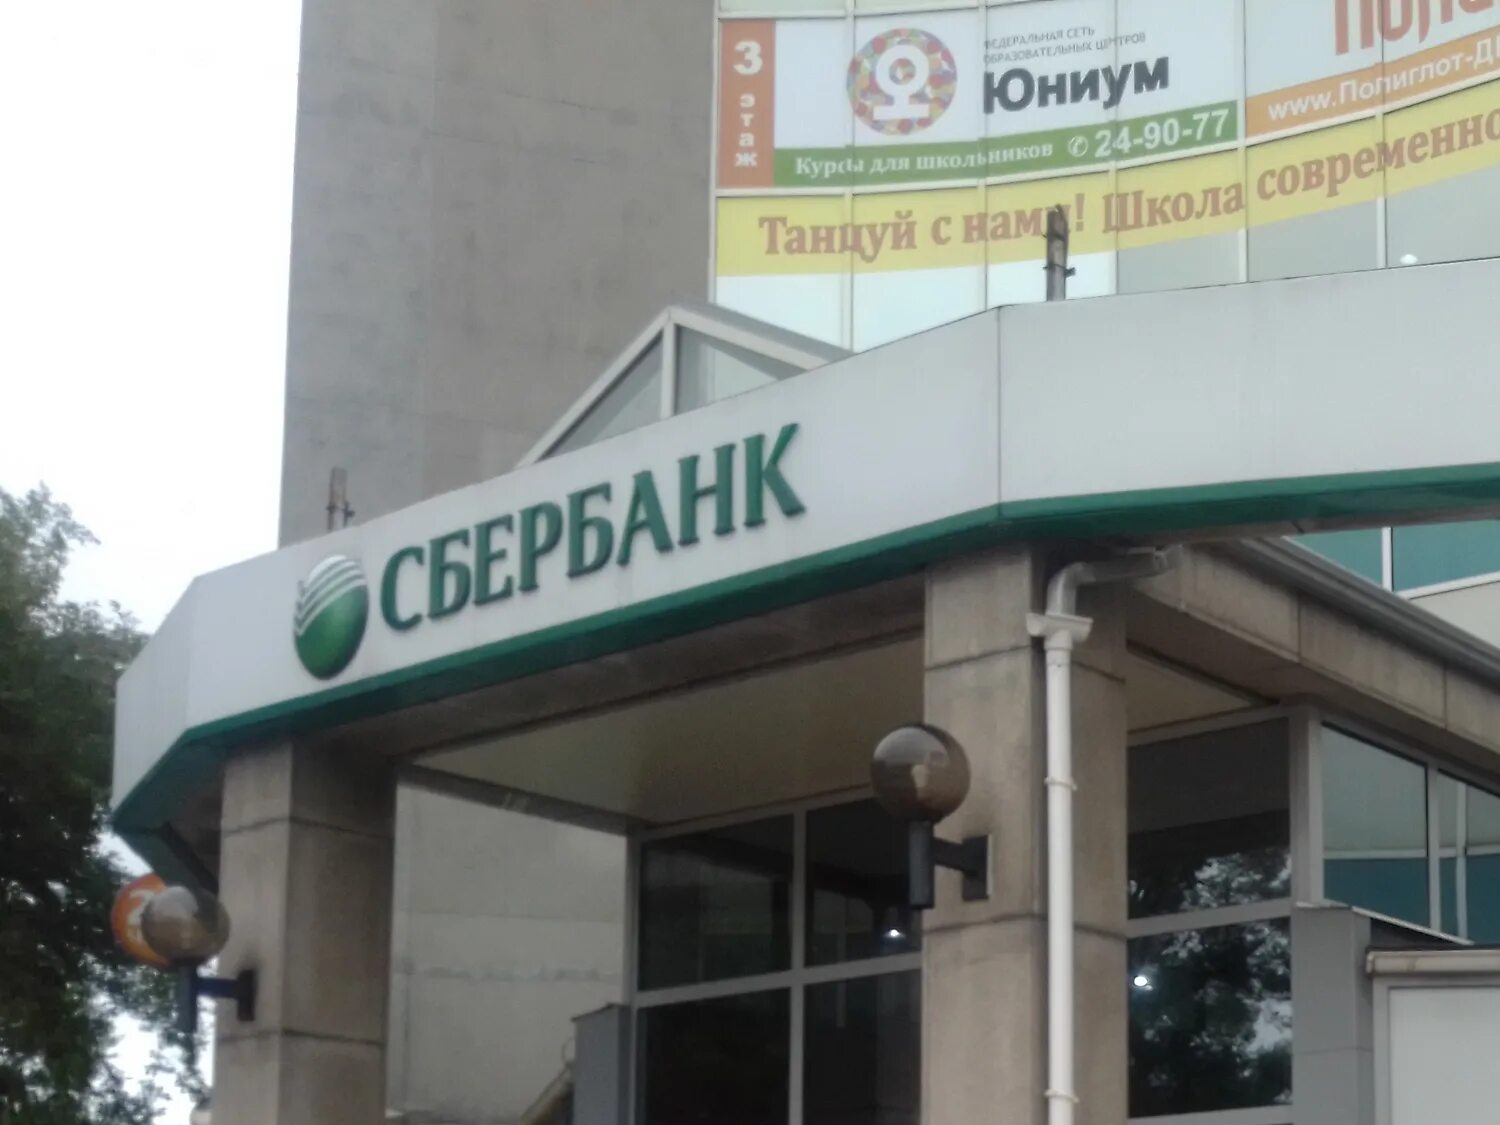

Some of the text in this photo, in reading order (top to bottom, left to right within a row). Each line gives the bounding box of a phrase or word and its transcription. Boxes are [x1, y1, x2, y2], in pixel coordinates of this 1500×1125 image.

[983, 32, 1147, 64] ОБРАЗОВАТЕЛЬНЫХ ЦЕНТРОВ
[984, 26, 1095, 51] ФЕДЕРАЛЬНАЯ СЕТЬ
[733, 40, 763, 167] 3 этаж
[983, 56, 1169, 114] Юниум
[796, 109, 1229, 178] Курсы для школьников 24-90-77
[758, 210, 917, 263] Танцуй
[931, 215, 952, 245] с
[962, 193, 1085, 243] нам!
[1102, 183, 1244, 233] Школа
[380, 423, 806, 631] СБЕРБАНК
